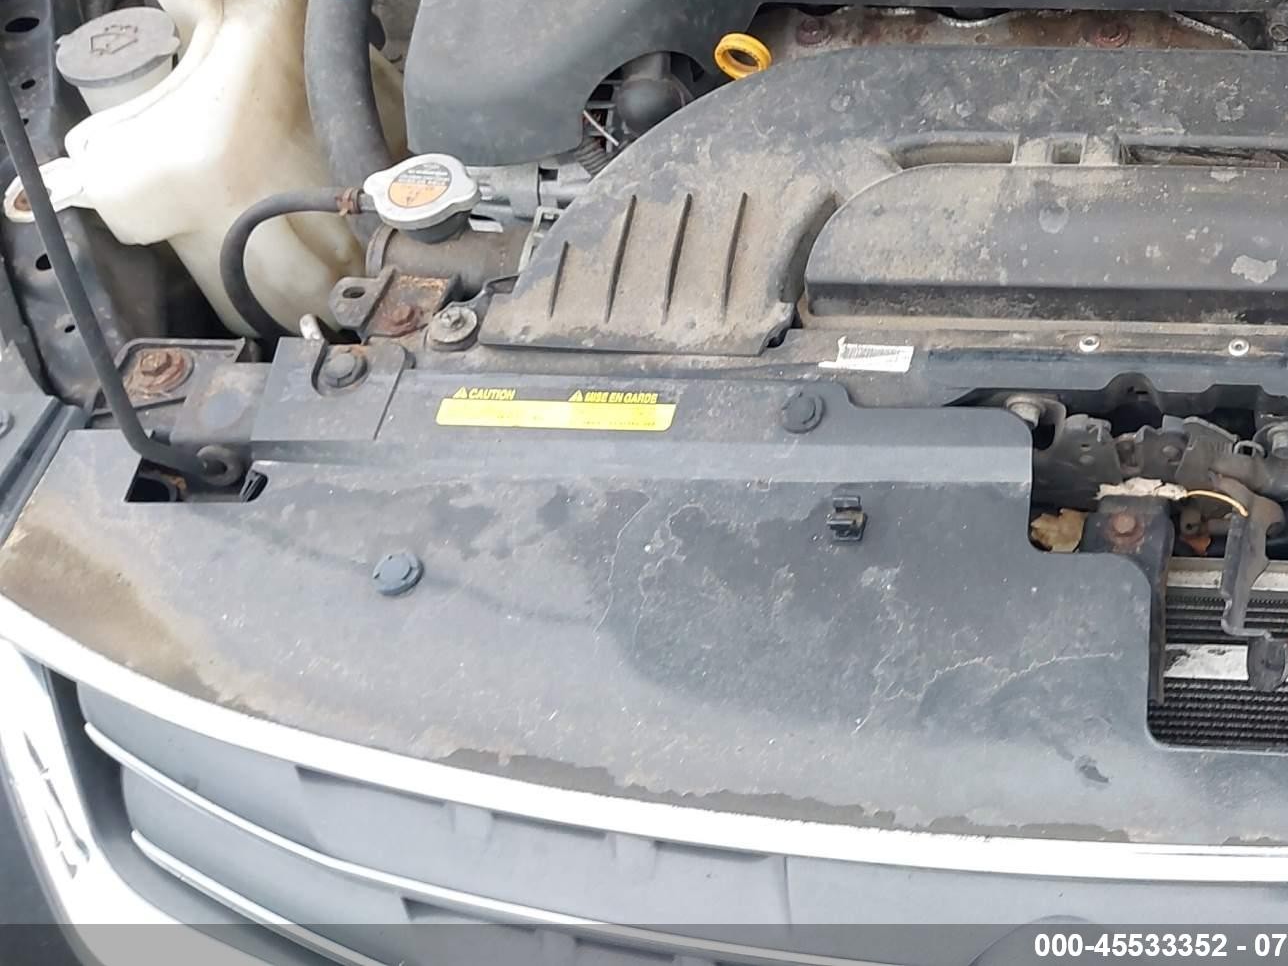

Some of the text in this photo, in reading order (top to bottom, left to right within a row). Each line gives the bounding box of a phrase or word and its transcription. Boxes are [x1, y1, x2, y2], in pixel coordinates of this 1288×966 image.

[468, 387, 516, 400] CAUTION
[608, 391, 625, 403] EN
[624, 392, 658, 404] GARDE
